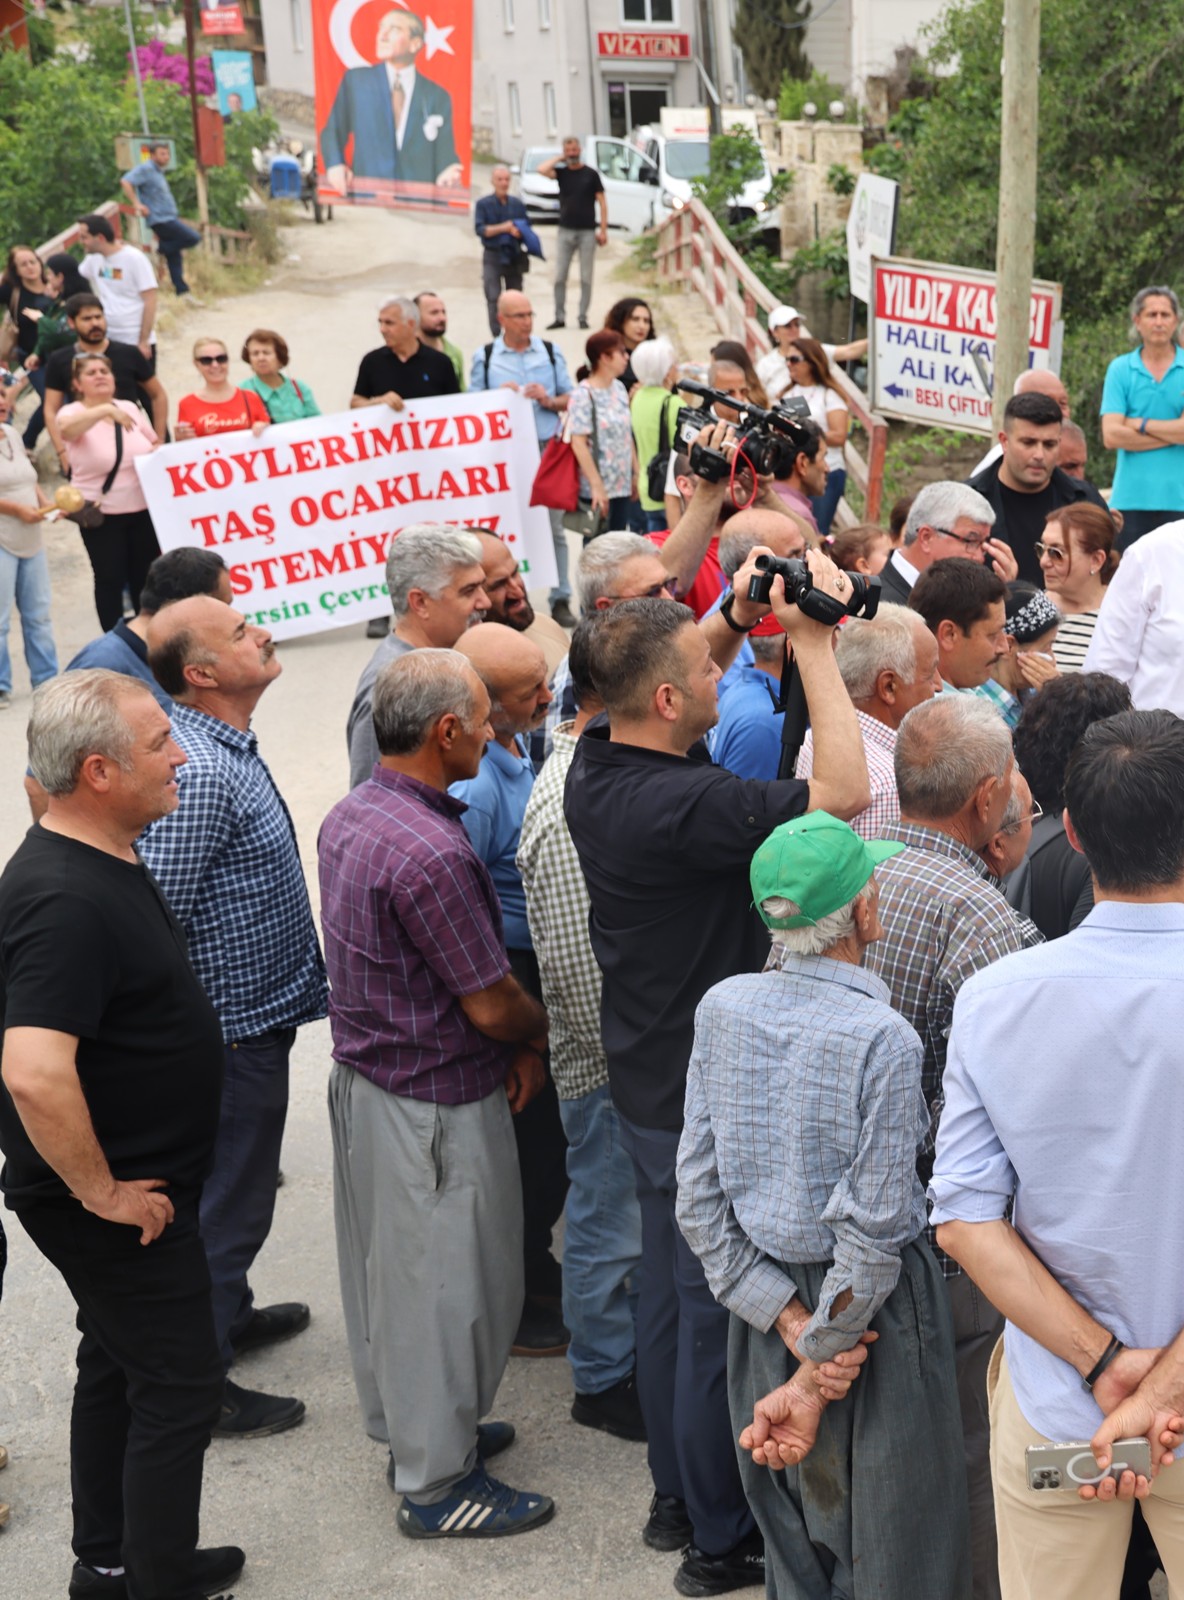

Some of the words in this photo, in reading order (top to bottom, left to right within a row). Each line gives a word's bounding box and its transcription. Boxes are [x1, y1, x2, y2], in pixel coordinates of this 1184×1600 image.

[882, 272, 953, 327] YILDIZ
[166, 409, 513, 497] KÖYLERİMİZDE
[191, 503, 276, 545] TAŞ
[290, 462, 511, 528] OCAKLARI
